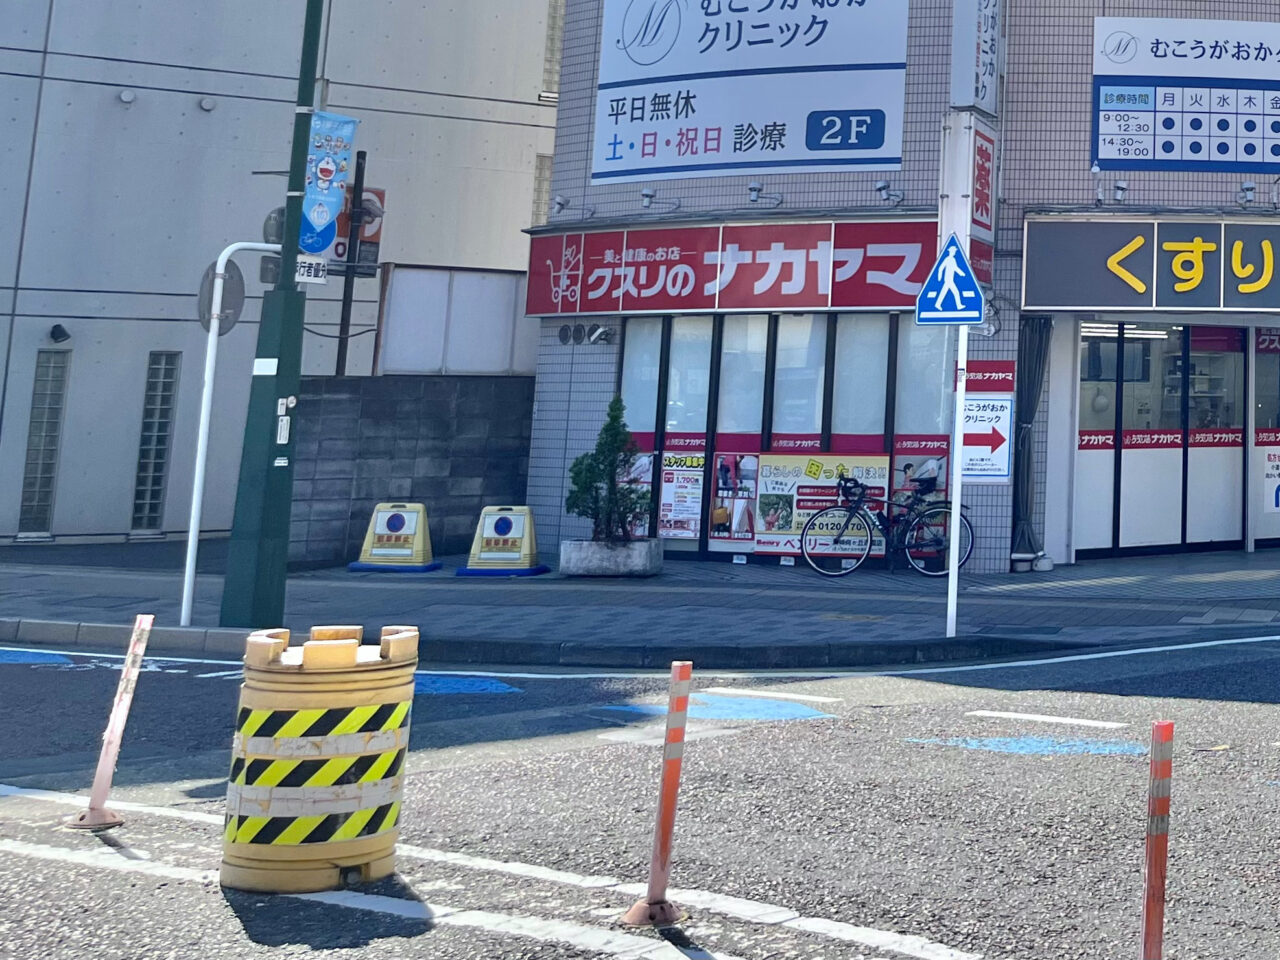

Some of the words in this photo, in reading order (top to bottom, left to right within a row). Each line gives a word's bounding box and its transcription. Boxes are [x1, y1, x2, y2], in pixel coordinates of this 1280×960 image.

[697, 14, 829, 54] クリニック
[608, 89, 697, 125] 平日無休
[1103, 93, 1150, 106] 診療時間
[1163, 92, 1175, 107] 月
[1190, 94, 1204, 108] 火
[1217, 95, 1231, 109] 水
[1244, 96, 1257, 110] 木
[819, 116, 871, 144] 2F
[1117, 123, 1150, 133] 12:30
[605, 126, 723, 161] 土・日・祝日
[732, 121, 787, 153] 診療
[1117, 147, 1149, 157] 19:00
[604, 246, 681, 263] 美と健康のお店
[1106, 235, 1274, 293] くすり
[964, 403, 1008, 412] こうがおか
[756, 539, 781, 548] Benry
